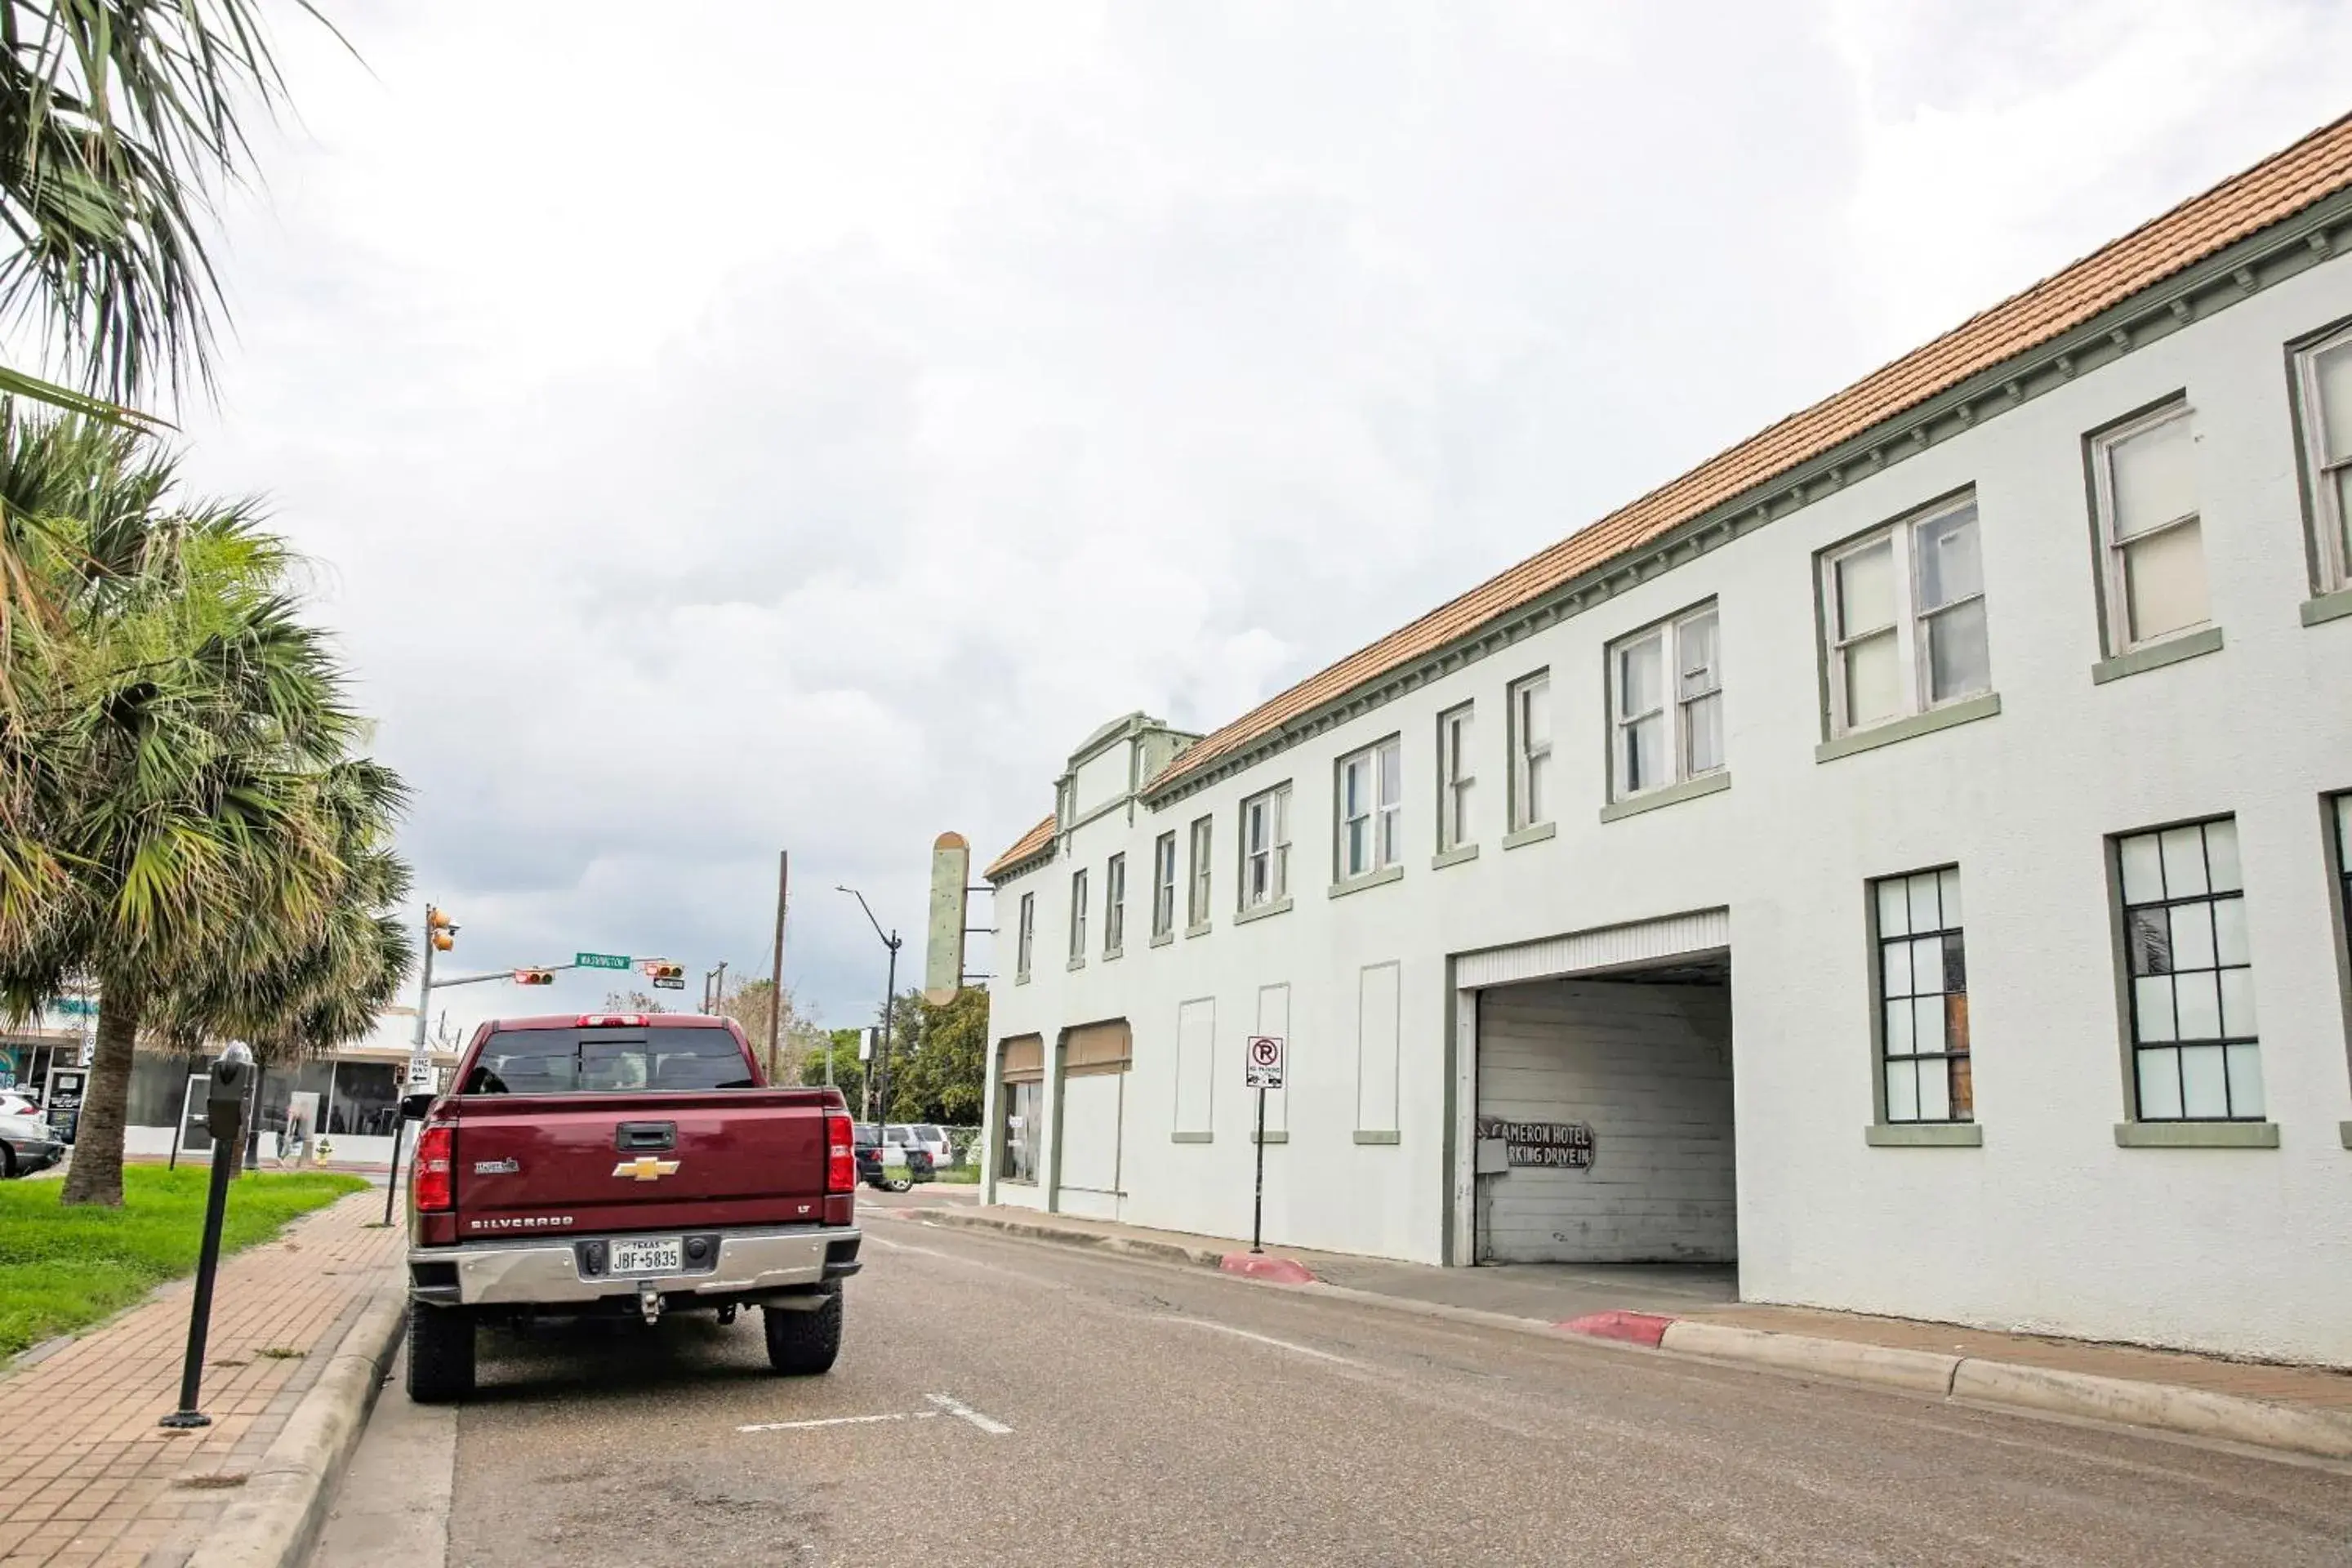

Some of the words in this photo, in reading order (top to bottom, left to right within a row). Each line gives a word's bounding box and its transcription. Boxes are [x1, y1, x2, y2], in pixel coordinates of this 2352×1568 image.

[1553, 1125, 1589, 1144] HOTEL
[1508, 1146, 1543, 1163] RKING
[471, 1216, 573, 1228] SILVERADO
[633, 1241, 660, 1250] TEXAS
